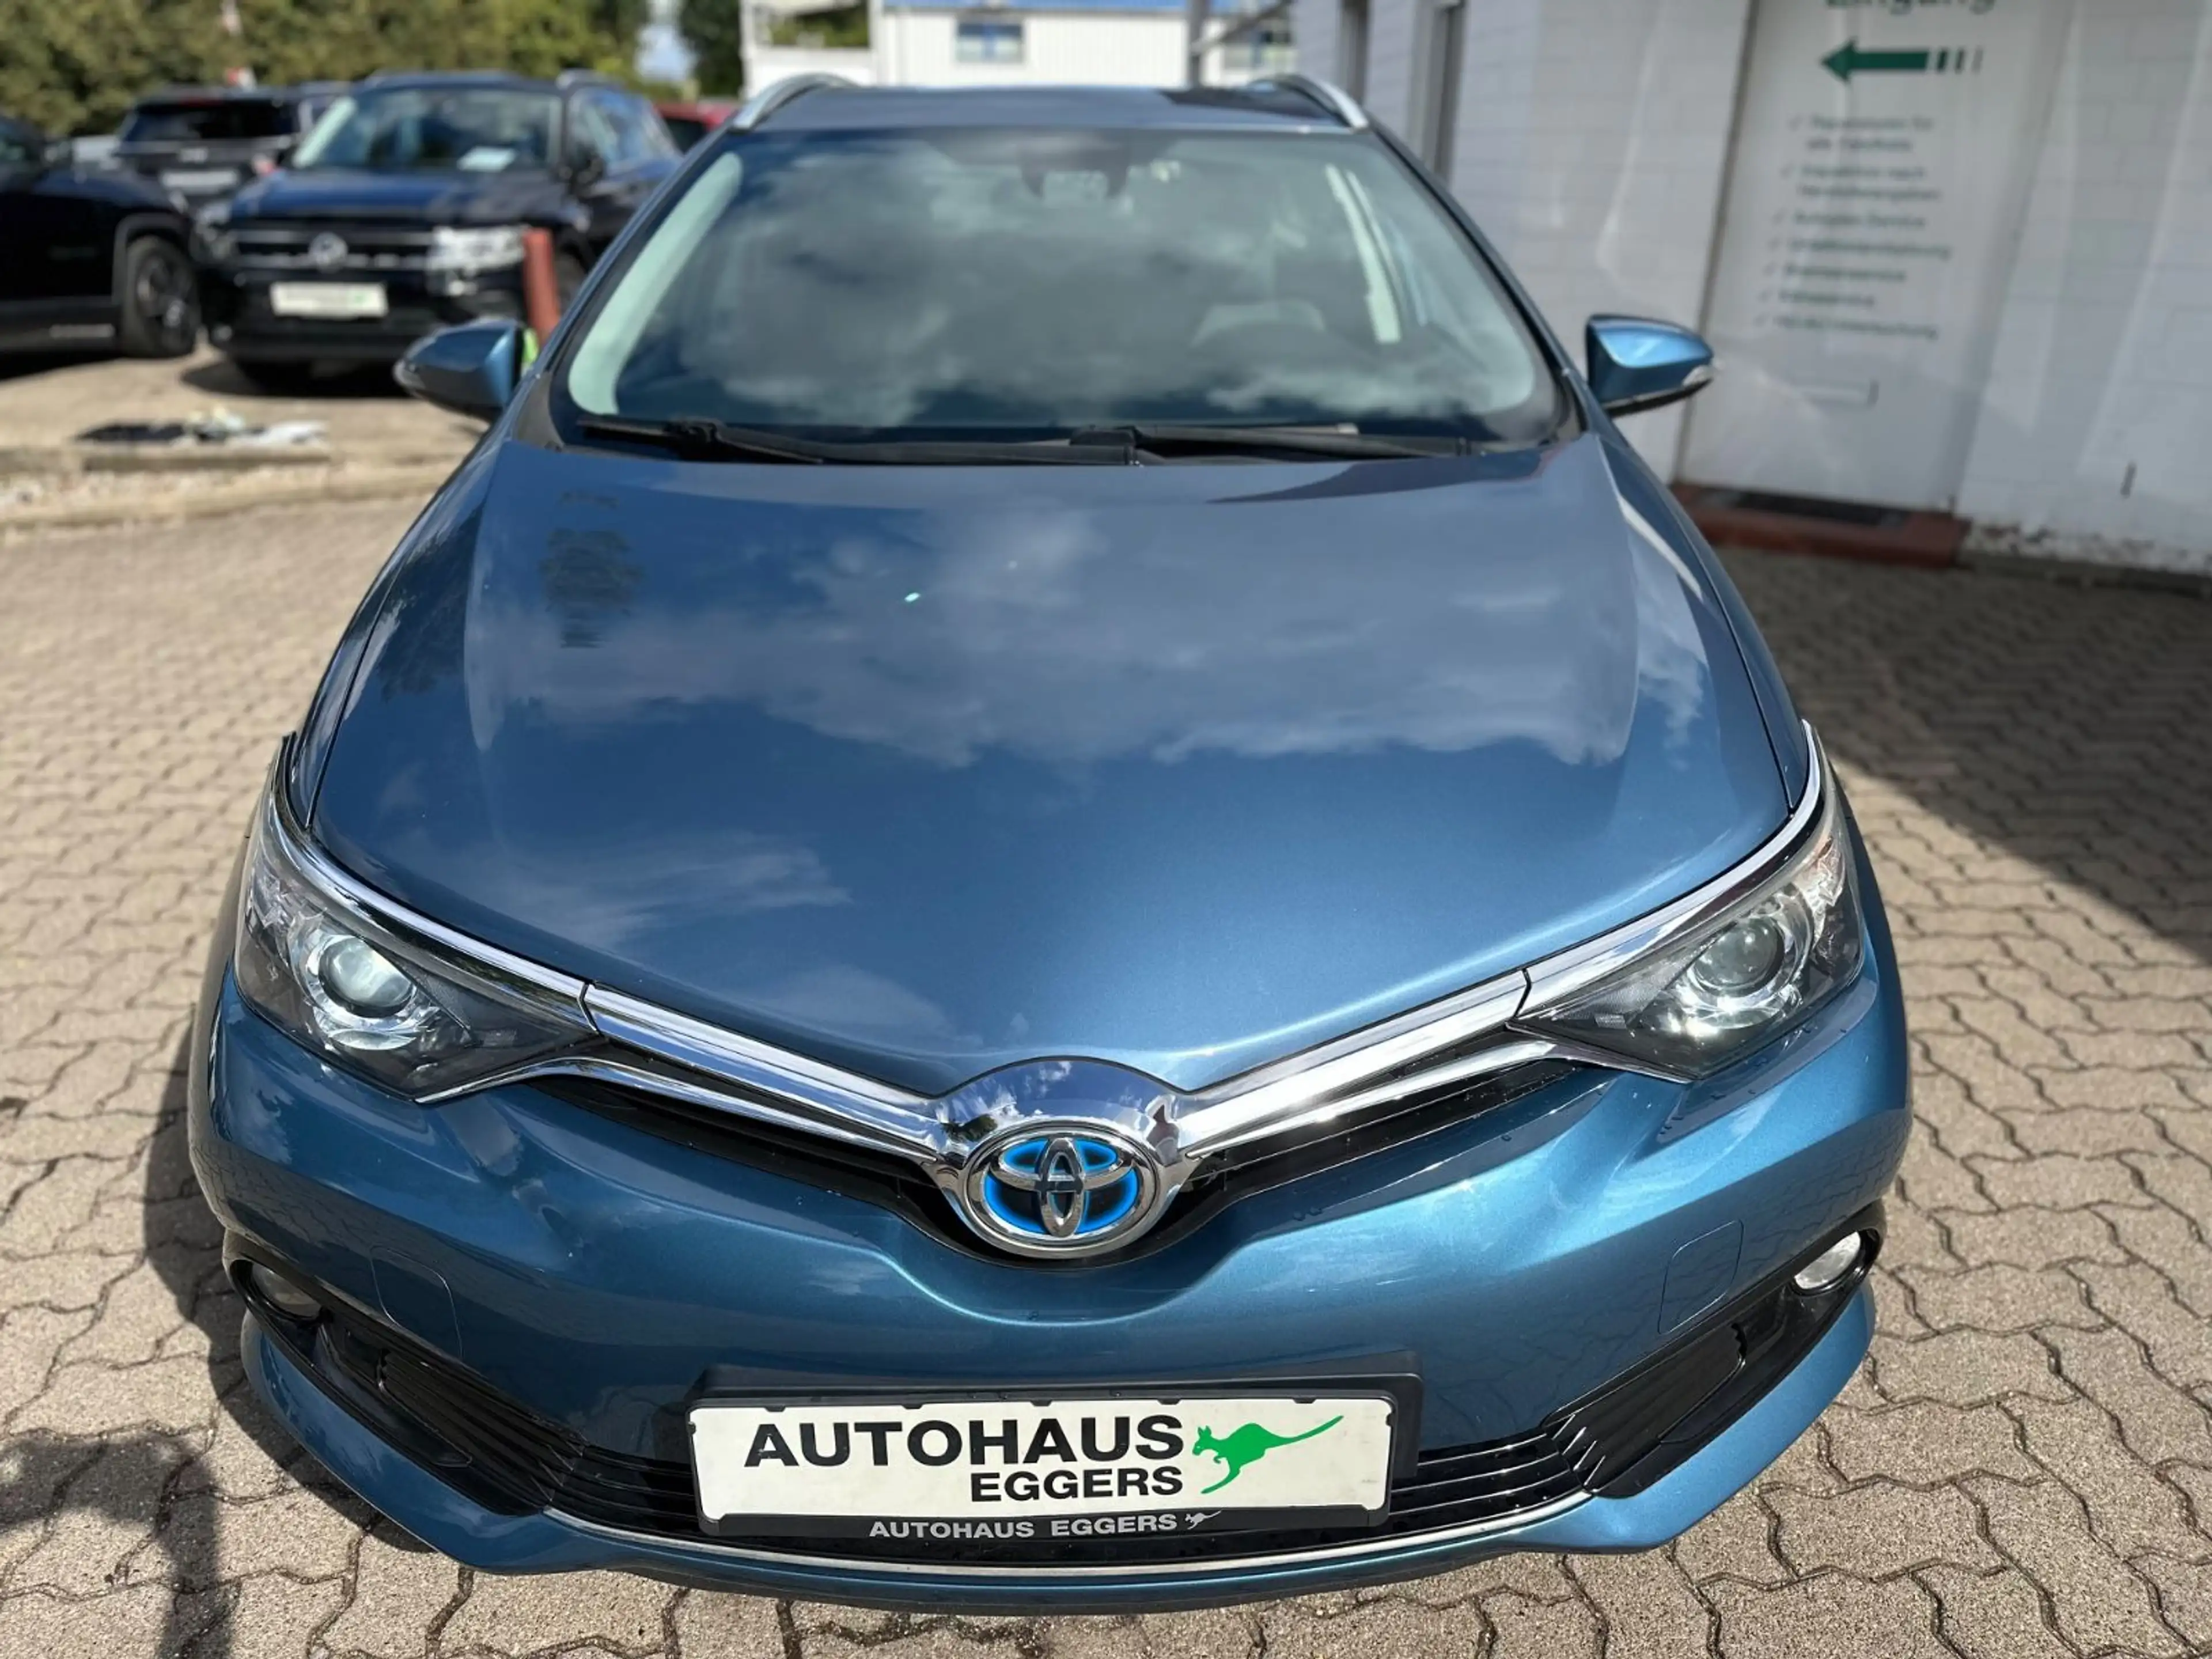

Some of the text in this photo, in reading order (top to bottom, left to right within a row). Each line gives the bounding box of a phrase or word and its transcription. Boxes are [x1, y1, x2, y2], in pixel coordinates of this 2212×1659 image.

[744, 1414, 1184, 1468] AUTOHAUS
[970, 1465, 1183, 1503] EGGERS
[869, 1513, 1179, 1539] AUTOHAUS EGGERS
